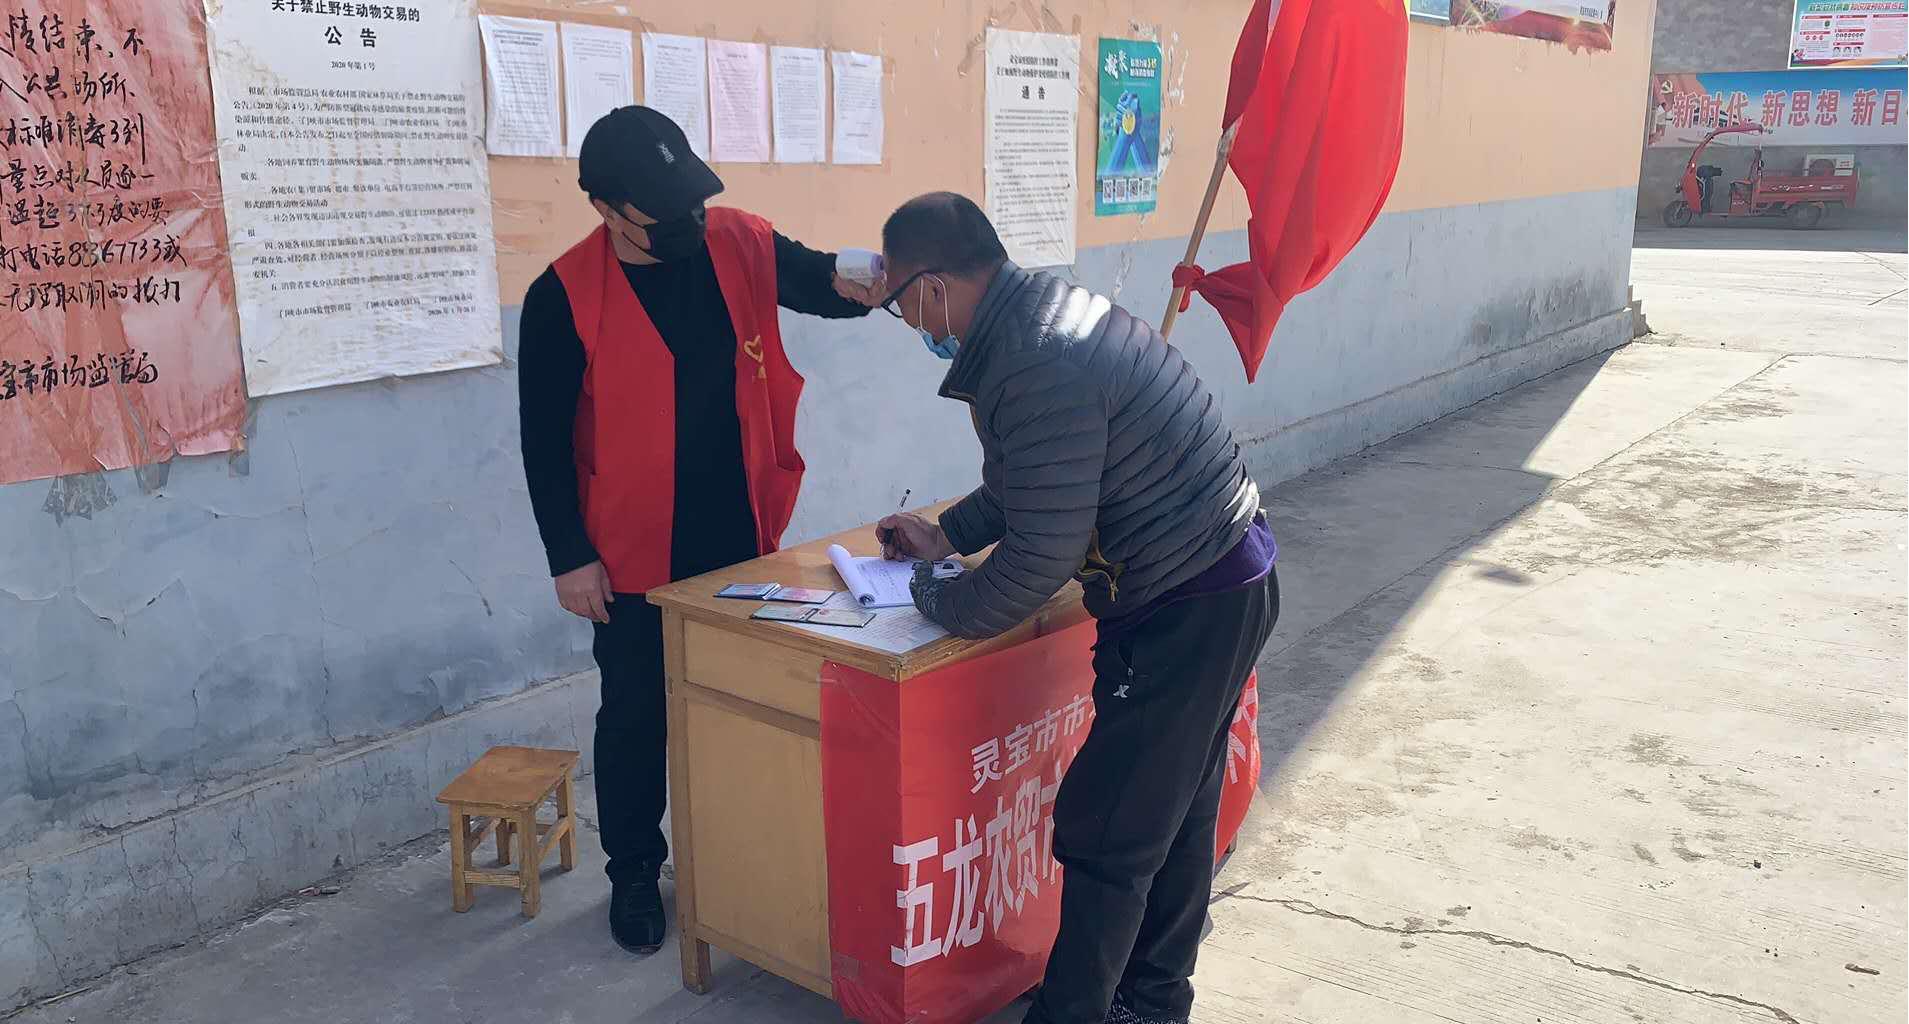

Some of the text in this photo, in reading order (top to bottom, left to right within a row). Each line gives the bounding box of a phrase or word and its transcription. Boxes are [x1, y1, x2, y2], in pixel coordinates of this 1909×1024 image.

[271, 0, 420, 22] 关于禁止野生动物交易的
[1673, 91, 1749, 128] 新时代
[1761, 89, 1840, 128] 新思想
[0, 158, 155, 194] 量点对人员逐一
[0, 276, 181, 314] 无理取闹的拨打
[0, 350, 158, 400] 宝市市场监管局
[970, 692, 1096, 794] 灵宝市市
